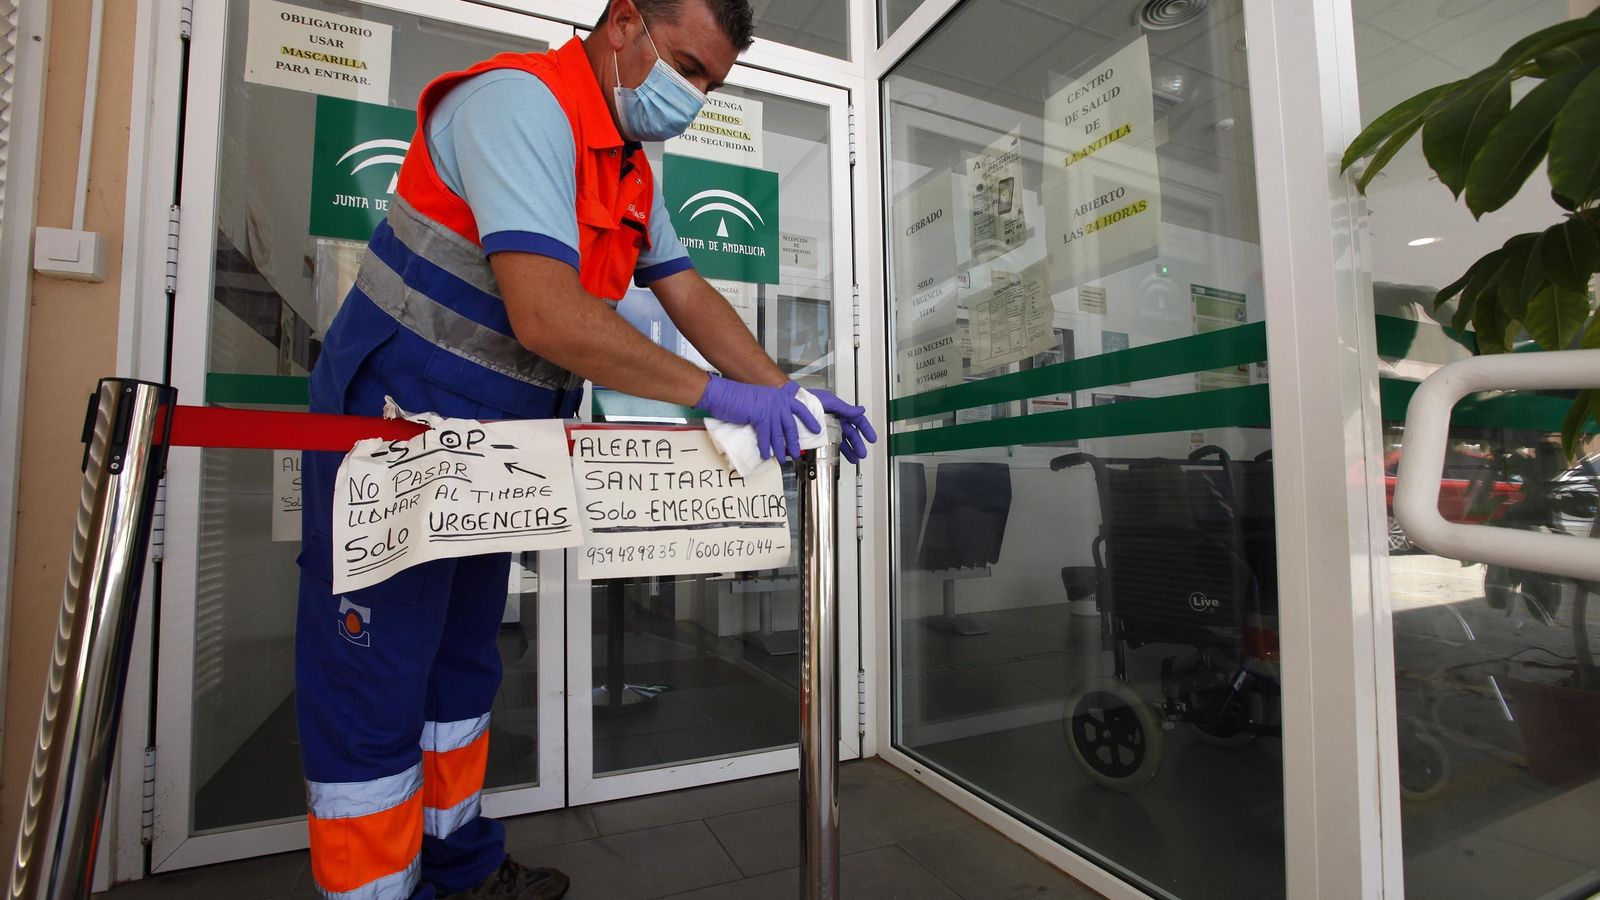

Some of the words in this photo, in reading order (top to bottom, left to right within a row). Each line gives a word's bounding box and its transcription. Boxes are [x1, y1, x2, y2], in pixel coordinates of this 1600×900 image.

[280, 12, 372, 38] OBLIGATORIO
[309, 34, 344, 49] USAR
[281, 46, 368, 70] MASCARILLA
[275, 61, 311, 75] PARA
[314, 68, 372, 86] ENTRAR.
[1067, 68, 1114, 104] CENTRO
[705, 98, 743, 112] NTENGA
[1064, 110, 1079, 127] DE
[1081, 86, 1121, 116] SALUD
[701, 110, 740, 124] METROS
[1085, 118, 1101, 135] DE
[679, 133, 698, 142] POR
[700, 136, 756, 153] SEGURIDAD.
[1064, 152, 1079, 168] LA
[1080, 124, 1132, 159] ANTILLA
[332, 194, 369, 209] JUNTA
[375, 198, 389, 211] DE
[1072, 186, 1126, 219] ABIERTO
[905, 208, 943, 237] CERRADO
[1062, 227, 1084, 245] LAS
[1085, 219, 1100, 234] 24
[1102, 200, 1148, 228] HORAS
[708, 240, 719, 251] DE
[917, 277, 934, 290] SOLO
[923, 336, 954, 353] NECESITA
[916, 357, 936, 370] LLAME
[580, 437, 672, 459] ALERTA
[349, 473, 379, 499] NO
[392, 461, 467, 492] PASAR
[585, 469, 745, 491] SANITARIA
[348, 494, 420, 528] LLAMAR
[435, 484, 459, 501] AL
[470, 485, 553, 504] TIMBRE
[429, 507, 568, 532] URGENCIAS
[1193, 596, 1220, 607] Live
